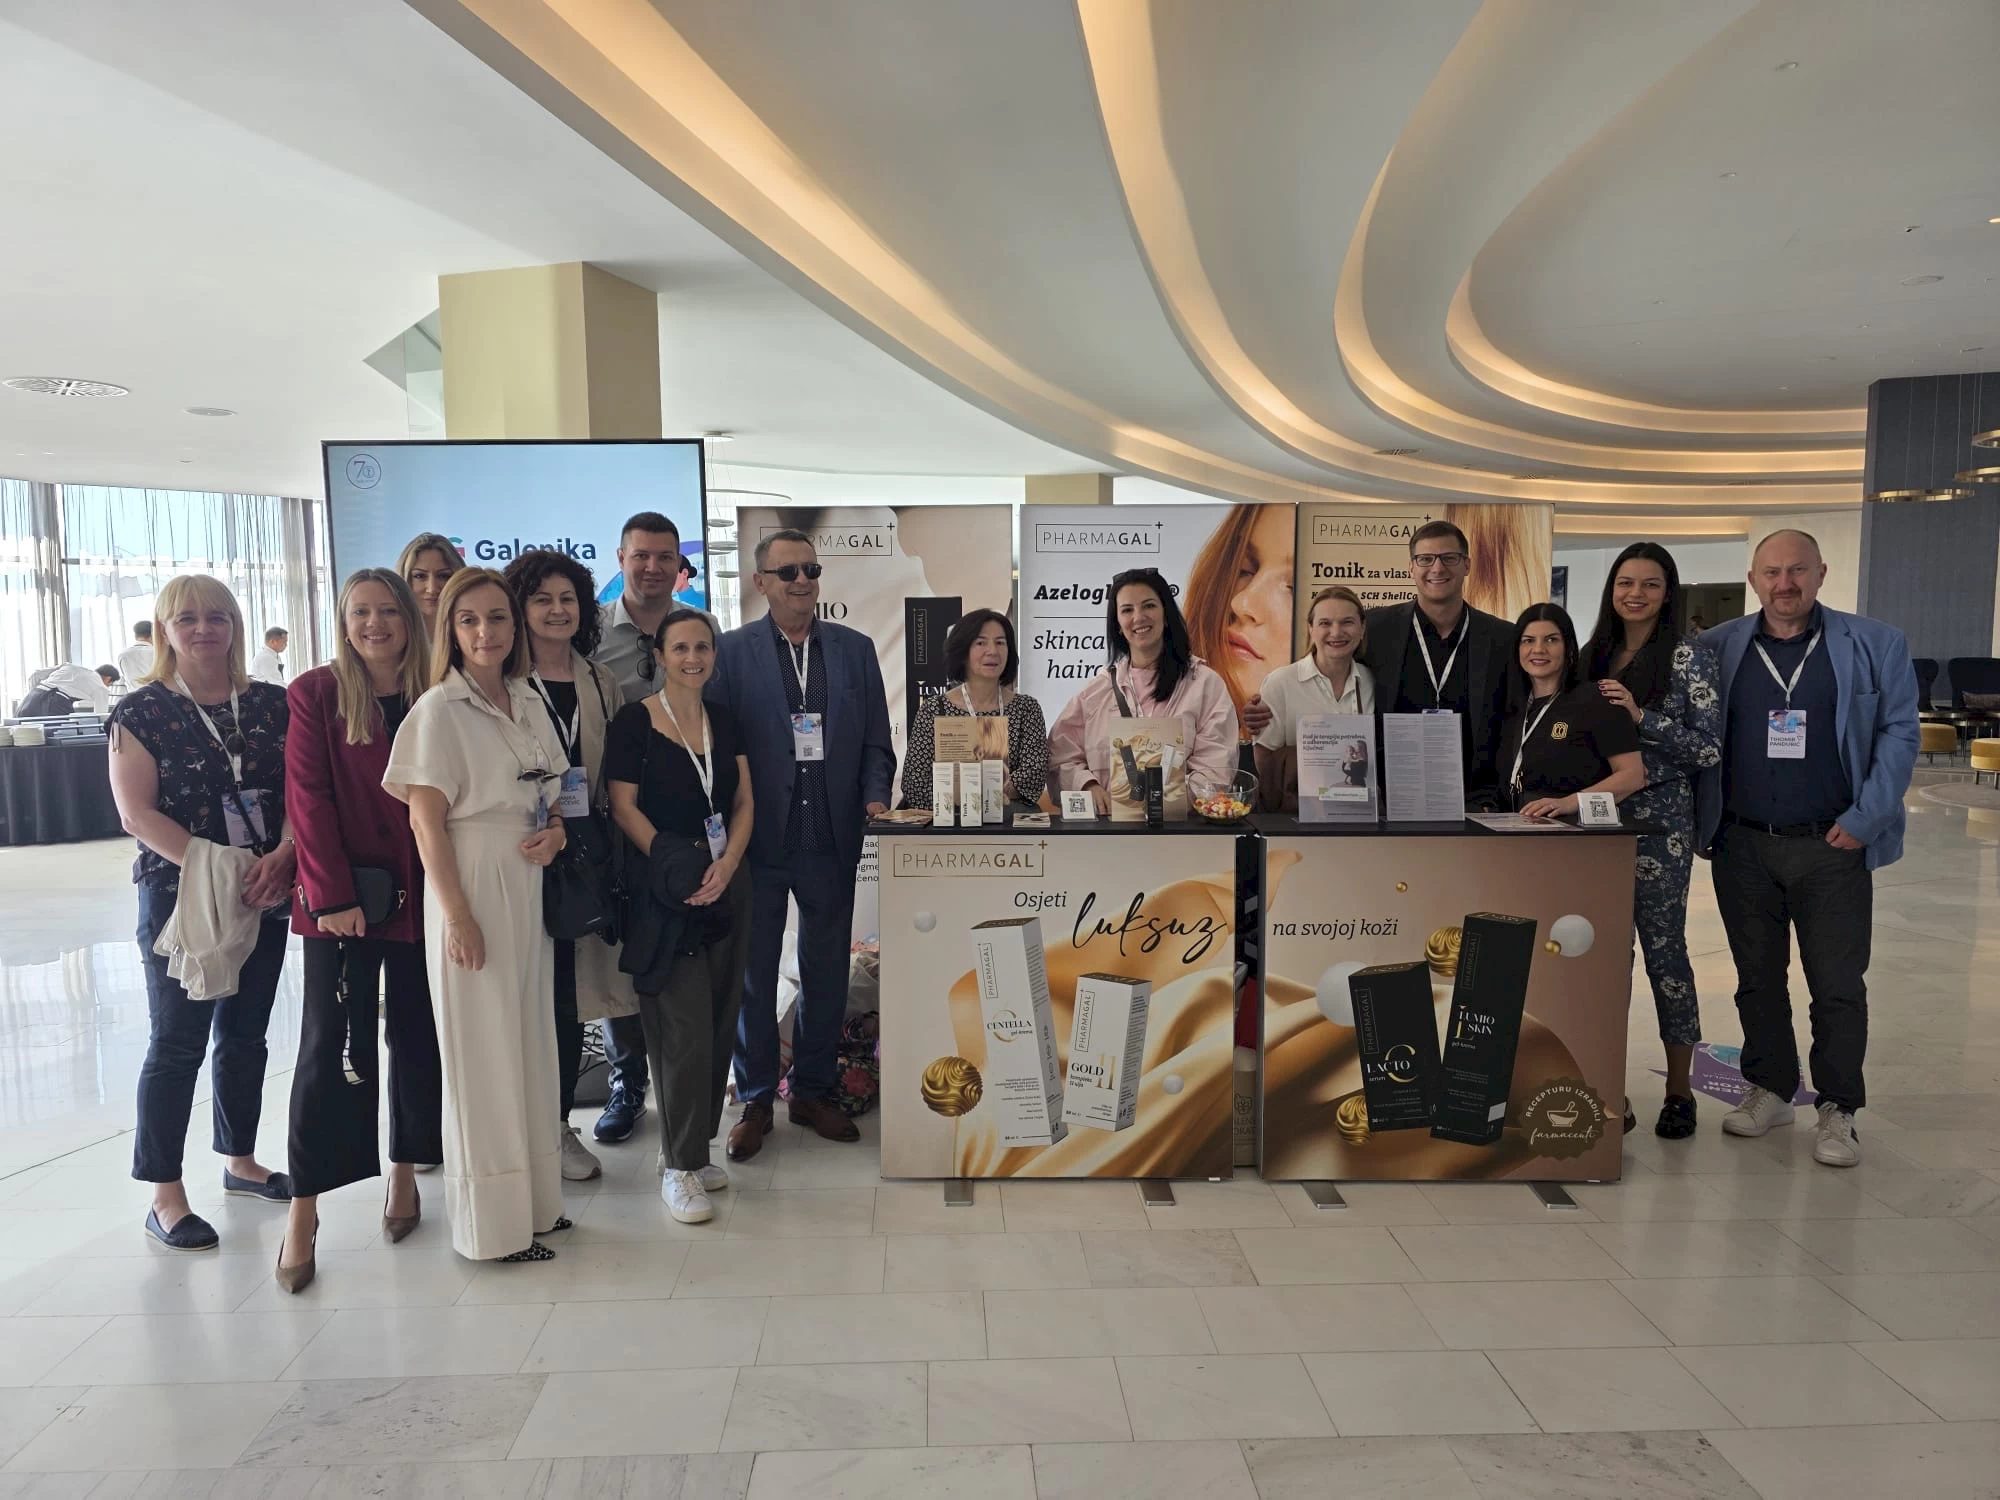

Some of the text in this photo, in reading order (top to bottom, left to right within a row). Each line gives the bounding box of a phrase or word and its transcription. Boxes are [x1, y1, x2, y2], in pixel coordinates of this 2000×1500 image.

[1043, 531, 1153, 545] PHARMAGAL
[1312, 562, 1365, 578] Tonik
[1367, 570, 1380, 578] za
[1360, 591, 1418, 600] SCH ShellCo
[1033, 630, 1105, 650] skinca
[902, 852, 1035, 869] PHARMAGAL
[1014, 891, 1227, 964] Osjeti luksuz
[1273, 918, 1400, 940] na svojoj koži
[983, 946, 995, 996] PHARMAGAL
[987, 1020, 1032, 1030] CENTELLA
[1078, 995, 1091, 1049] PHARMAGAL
[1468, 1023, 1492, 1035] SKIN
[1071, 1062, 1104, 1076] GOLD
[1367, 1060, 1410, 1073] LACTO
[1525, 1086, 1572, 1117] RECEPTURU
[1575, 1088, 1601, 1122] IZRADILI
[1530, 1125, 1597, 1145] farmaceuti
